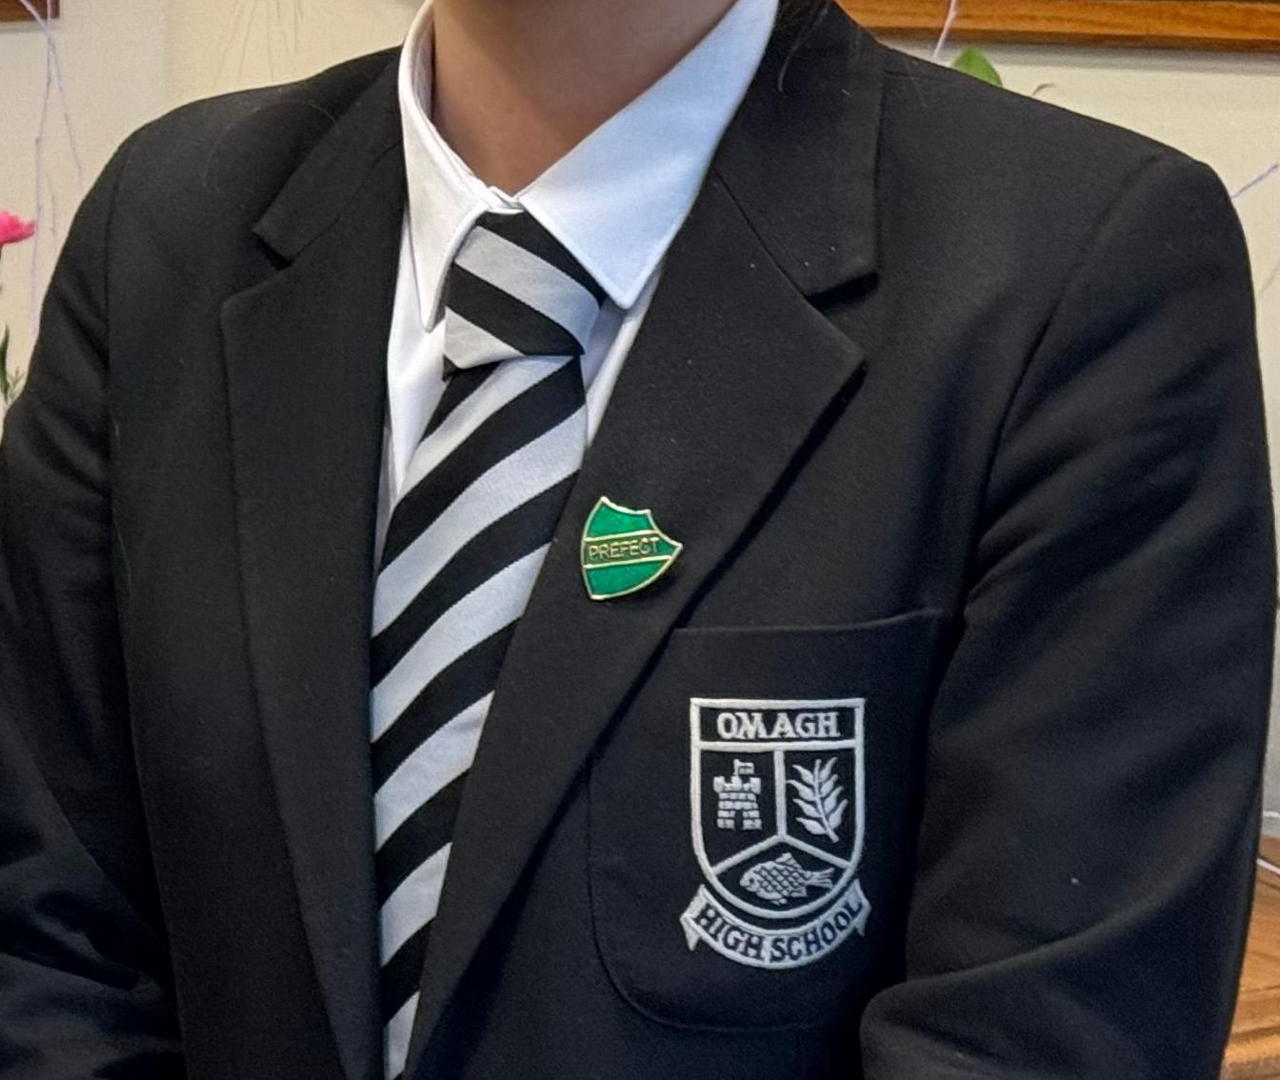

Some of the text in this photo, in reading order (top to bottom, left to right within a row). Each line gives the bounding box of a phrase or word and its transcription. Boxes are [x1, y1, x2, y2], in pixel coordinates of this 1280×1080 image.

[588, 536, 660, 561] PREFECT
[715, 710, 841, 742] OMAGH
[692, 898, 865, 964] HIGH SCHOOL
